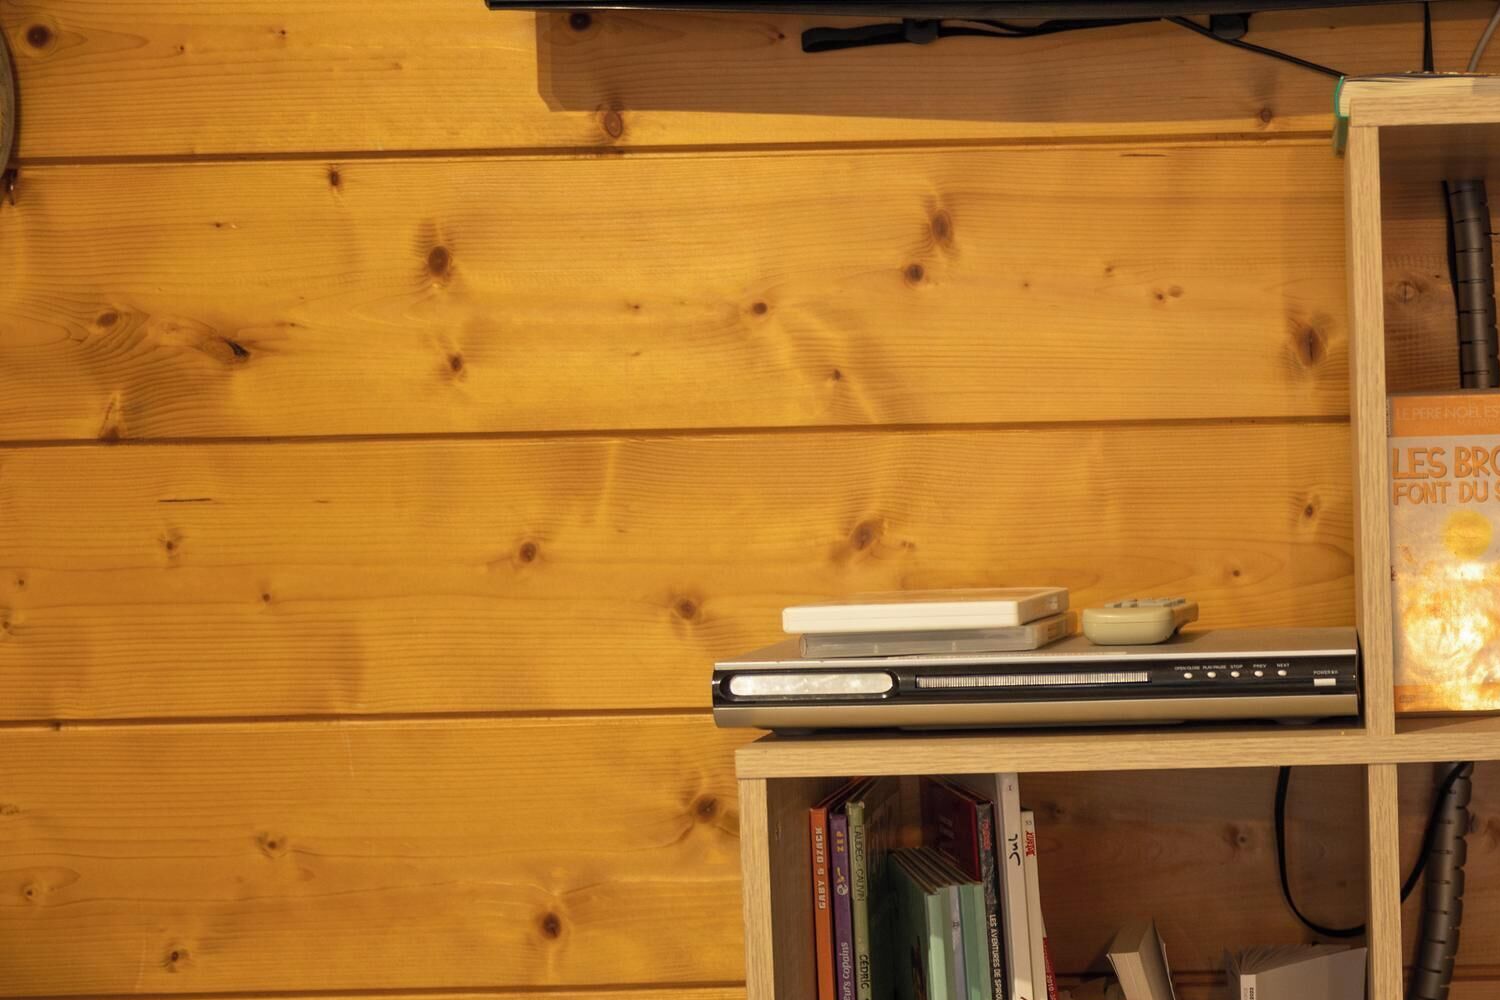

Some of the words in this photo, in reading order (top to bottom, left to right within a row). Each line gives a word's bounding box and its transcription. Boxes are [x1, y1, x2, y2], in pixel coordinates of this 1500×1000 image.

[1392, 448, 1447, 478] LES
[1394, 481, 1452, 505] FONT
[1458, 480, 1488, 503] DU
[840, 942, 850, 979] copains
[990, 928, 1000, 968] AVENTURES
[994, 968, 1001, 978] DE
